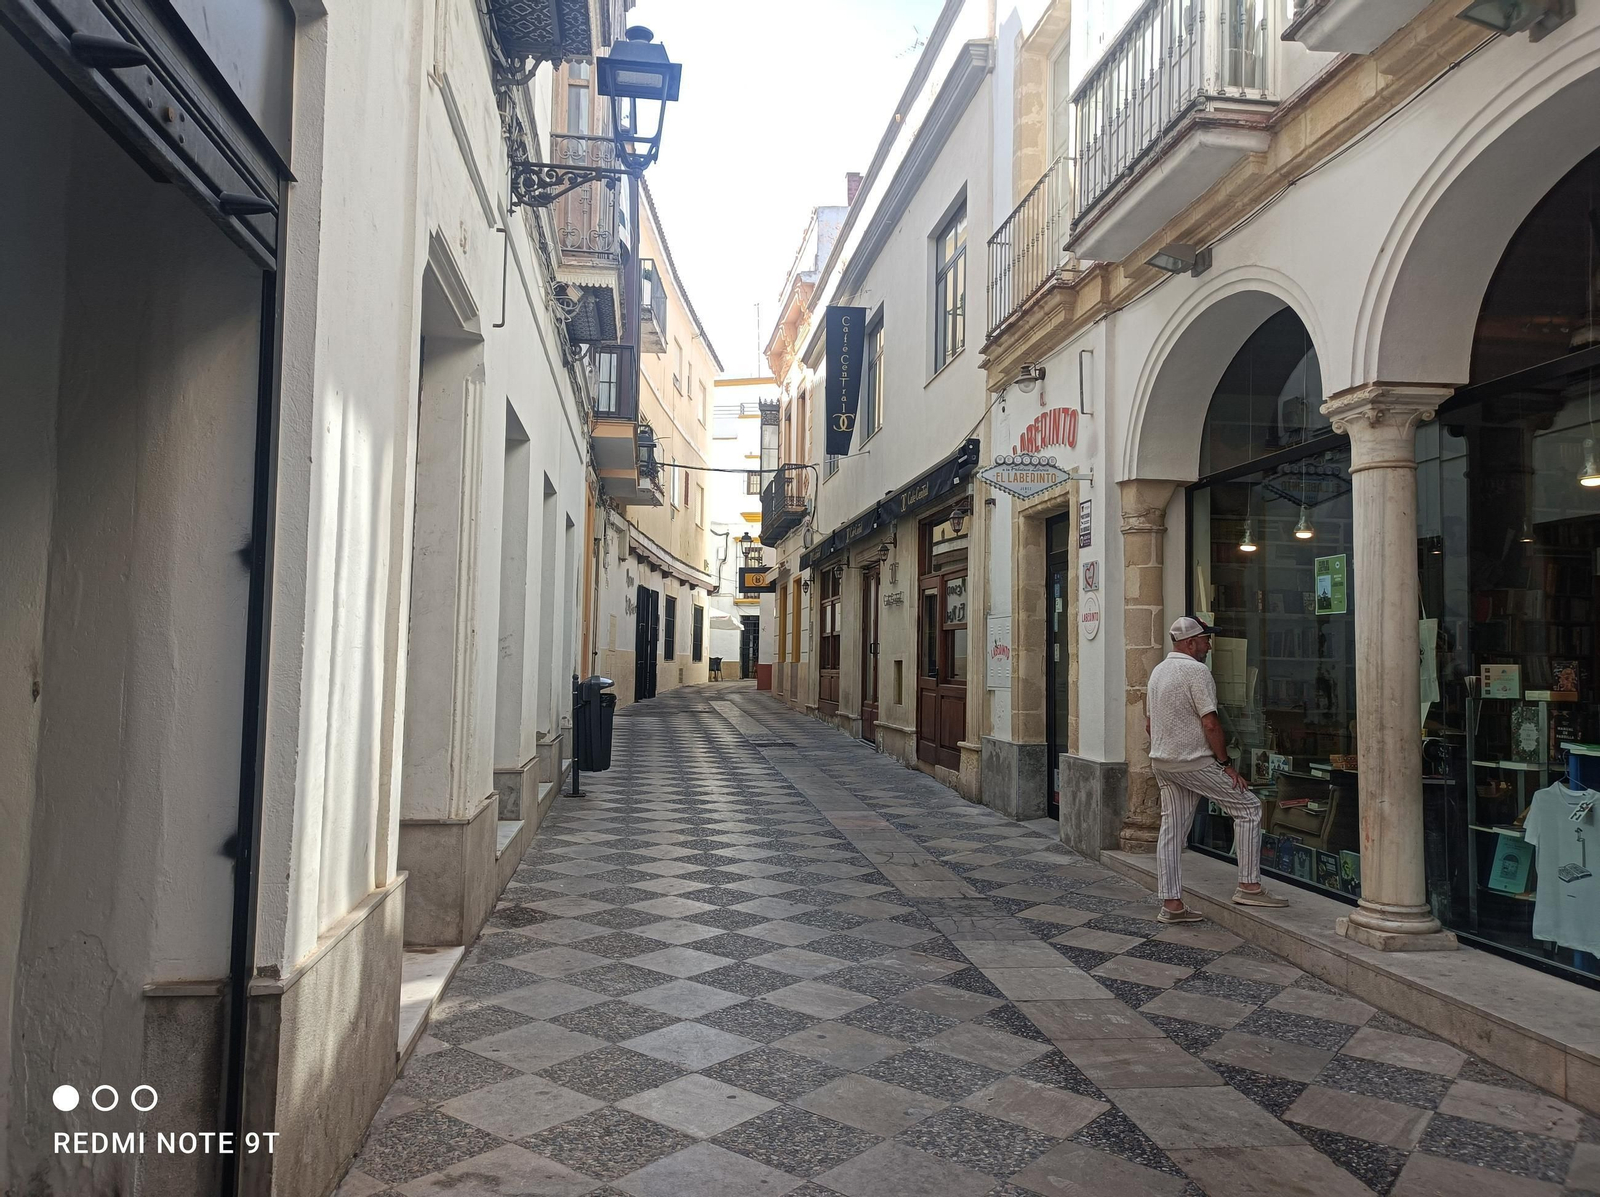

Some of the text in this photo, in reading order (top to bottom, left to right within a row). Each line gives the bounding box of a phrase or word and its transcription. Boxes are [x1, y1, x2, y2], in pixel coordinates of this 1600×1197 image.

[996, 472, 1057, 484] EL LABERINTO
[1082, 612, 1099, 622] LABERINTO
